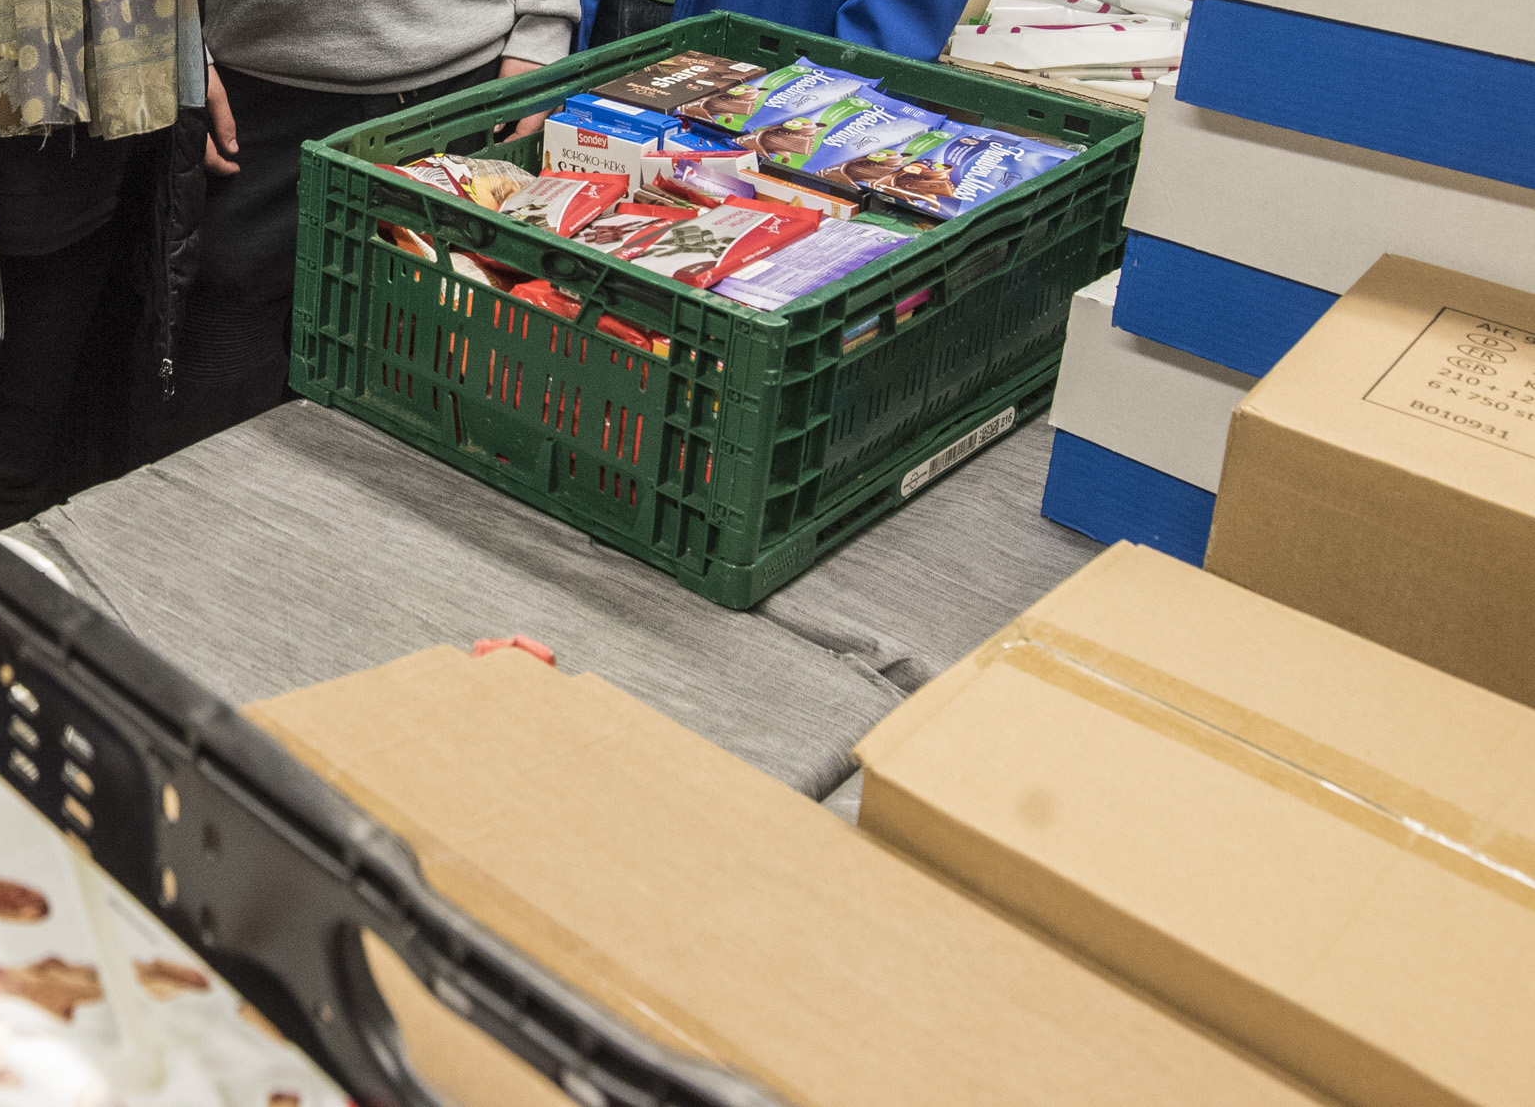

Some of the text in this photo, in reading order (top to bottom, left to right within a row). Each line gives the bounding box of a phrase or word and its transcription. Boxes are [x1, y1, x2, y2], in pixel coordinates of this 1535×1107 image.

[650, 65, 709, 88] share
[764, 68, 835, 109] Haselnuss
[822, 104, 897, 148] Haselnuss
[577, 132, 608, 149] Sondey
[561, 147, 626, 174] SCHOKO-KEKS
[1475, 322, 1516, 339] Art.
[1482, 337, 1499, 347] D
[1466, 347, 1494, 362] FR
[1456, 358, 1488, 375] GR
[1436, 366, 1481, 387] 210
[1427, 379, 1443, 390] 6
[1467, 391, 1510, 412] 750
[1000, 412, 1013, 428] 216
